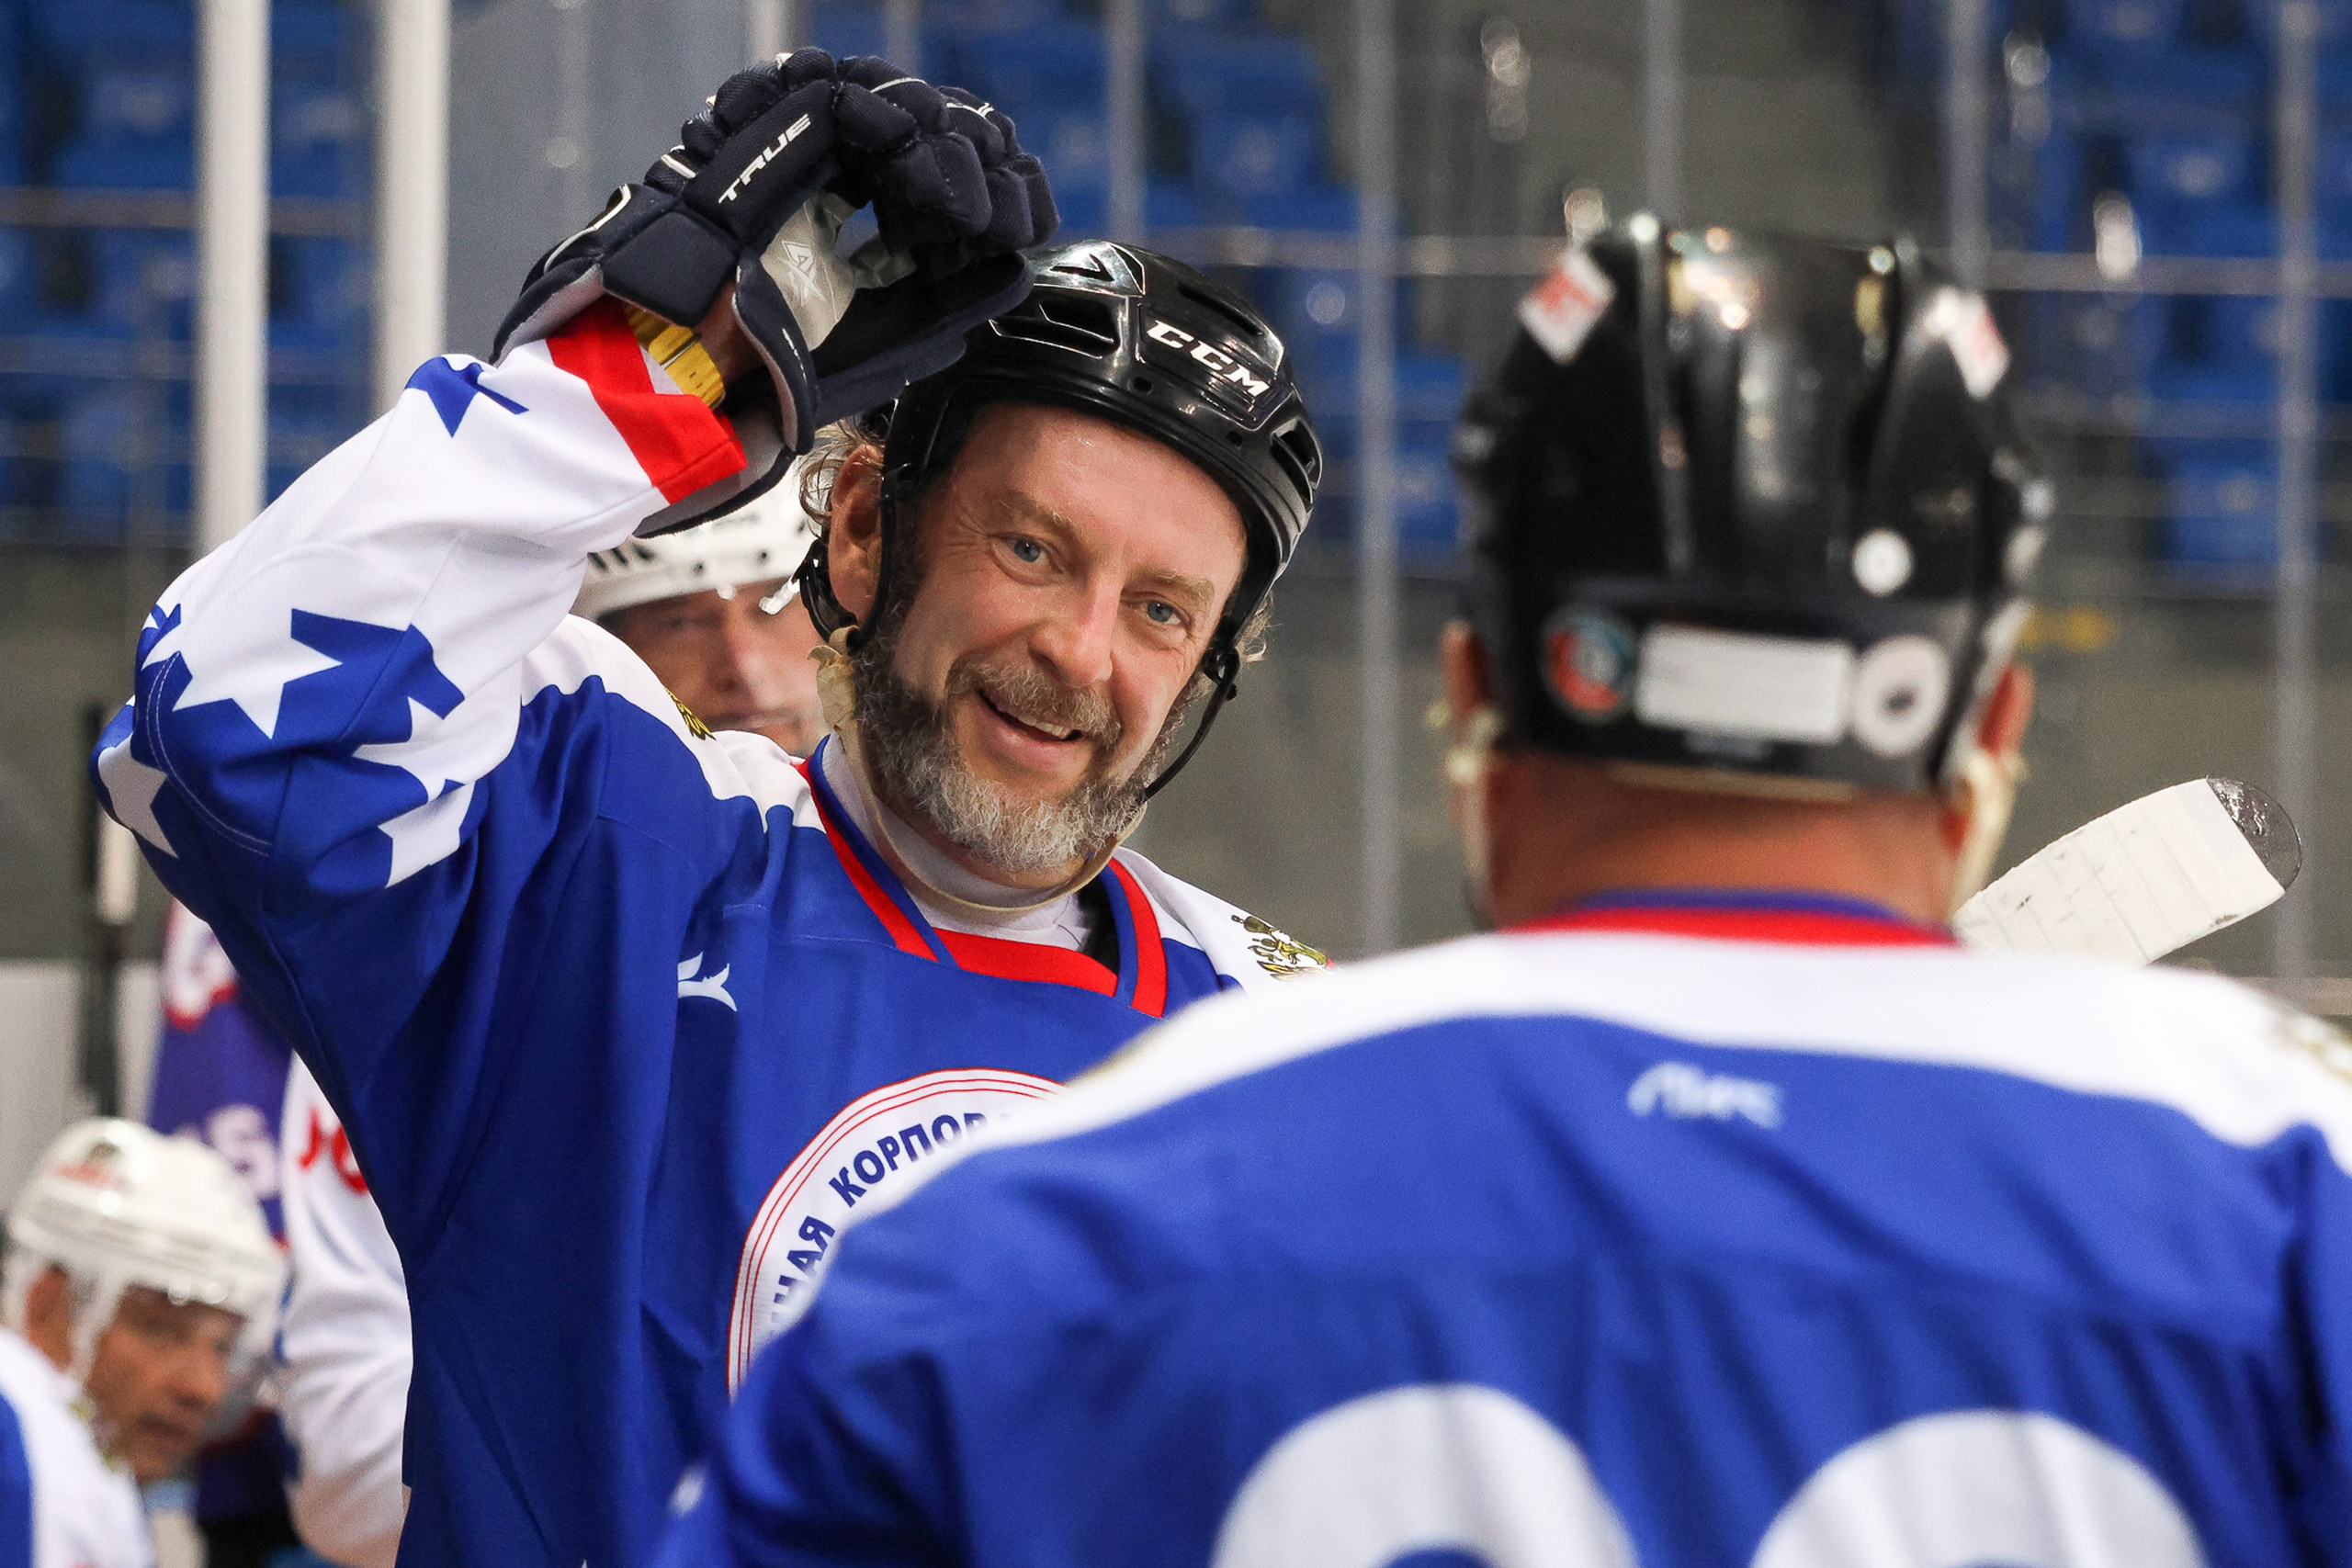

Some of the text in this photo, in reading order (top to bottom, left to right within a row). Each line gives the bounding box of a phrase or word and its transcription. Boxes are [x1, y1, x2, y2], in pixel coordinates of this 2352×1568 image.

[718, 113, 811, 204] TRUE
[1147, 320, 1271, 397] CCM
[828, 1112, 1009, 1208] КОРПОР
